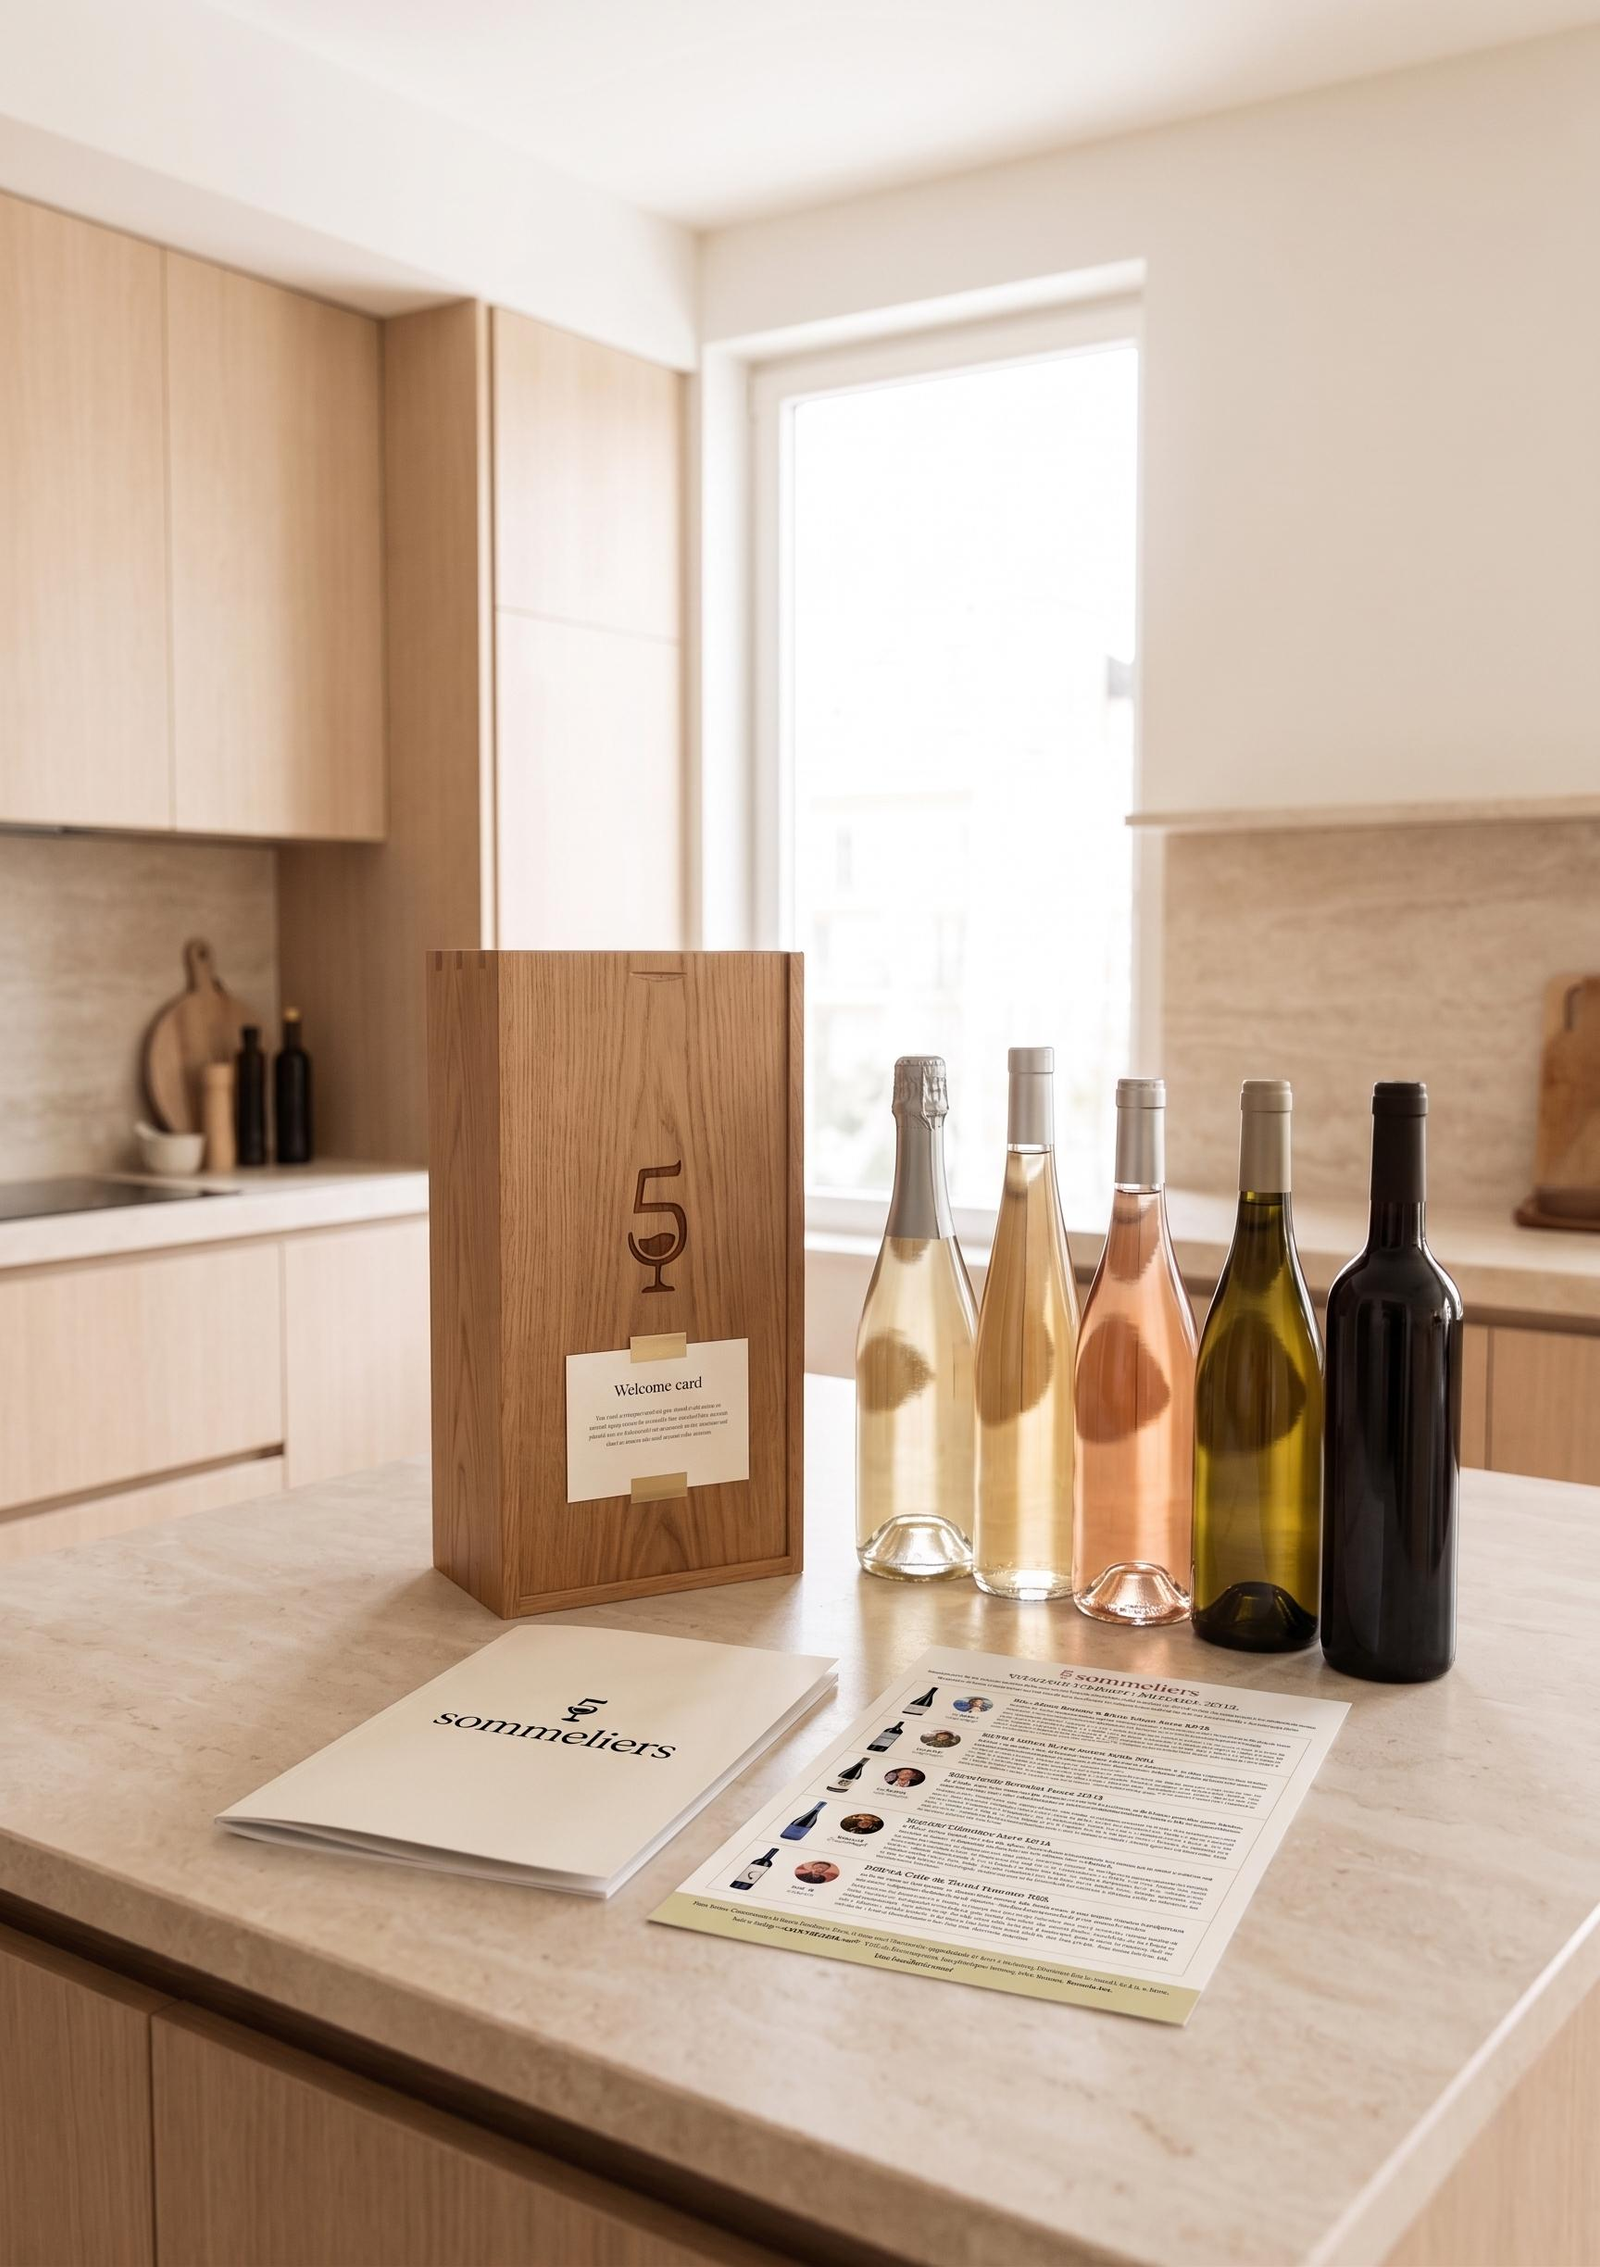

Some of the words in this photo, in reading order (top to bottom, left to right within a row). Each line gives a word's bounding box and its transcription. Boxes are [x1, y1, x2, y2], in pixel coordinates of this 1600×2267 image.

[614, 1381, 672, 1397] Welcome
[675, 1376, 702, 1391] card
[1076, 1673, 1200, 1697] sommeliers
[433, 1712, 676, 1759] sommeliers
